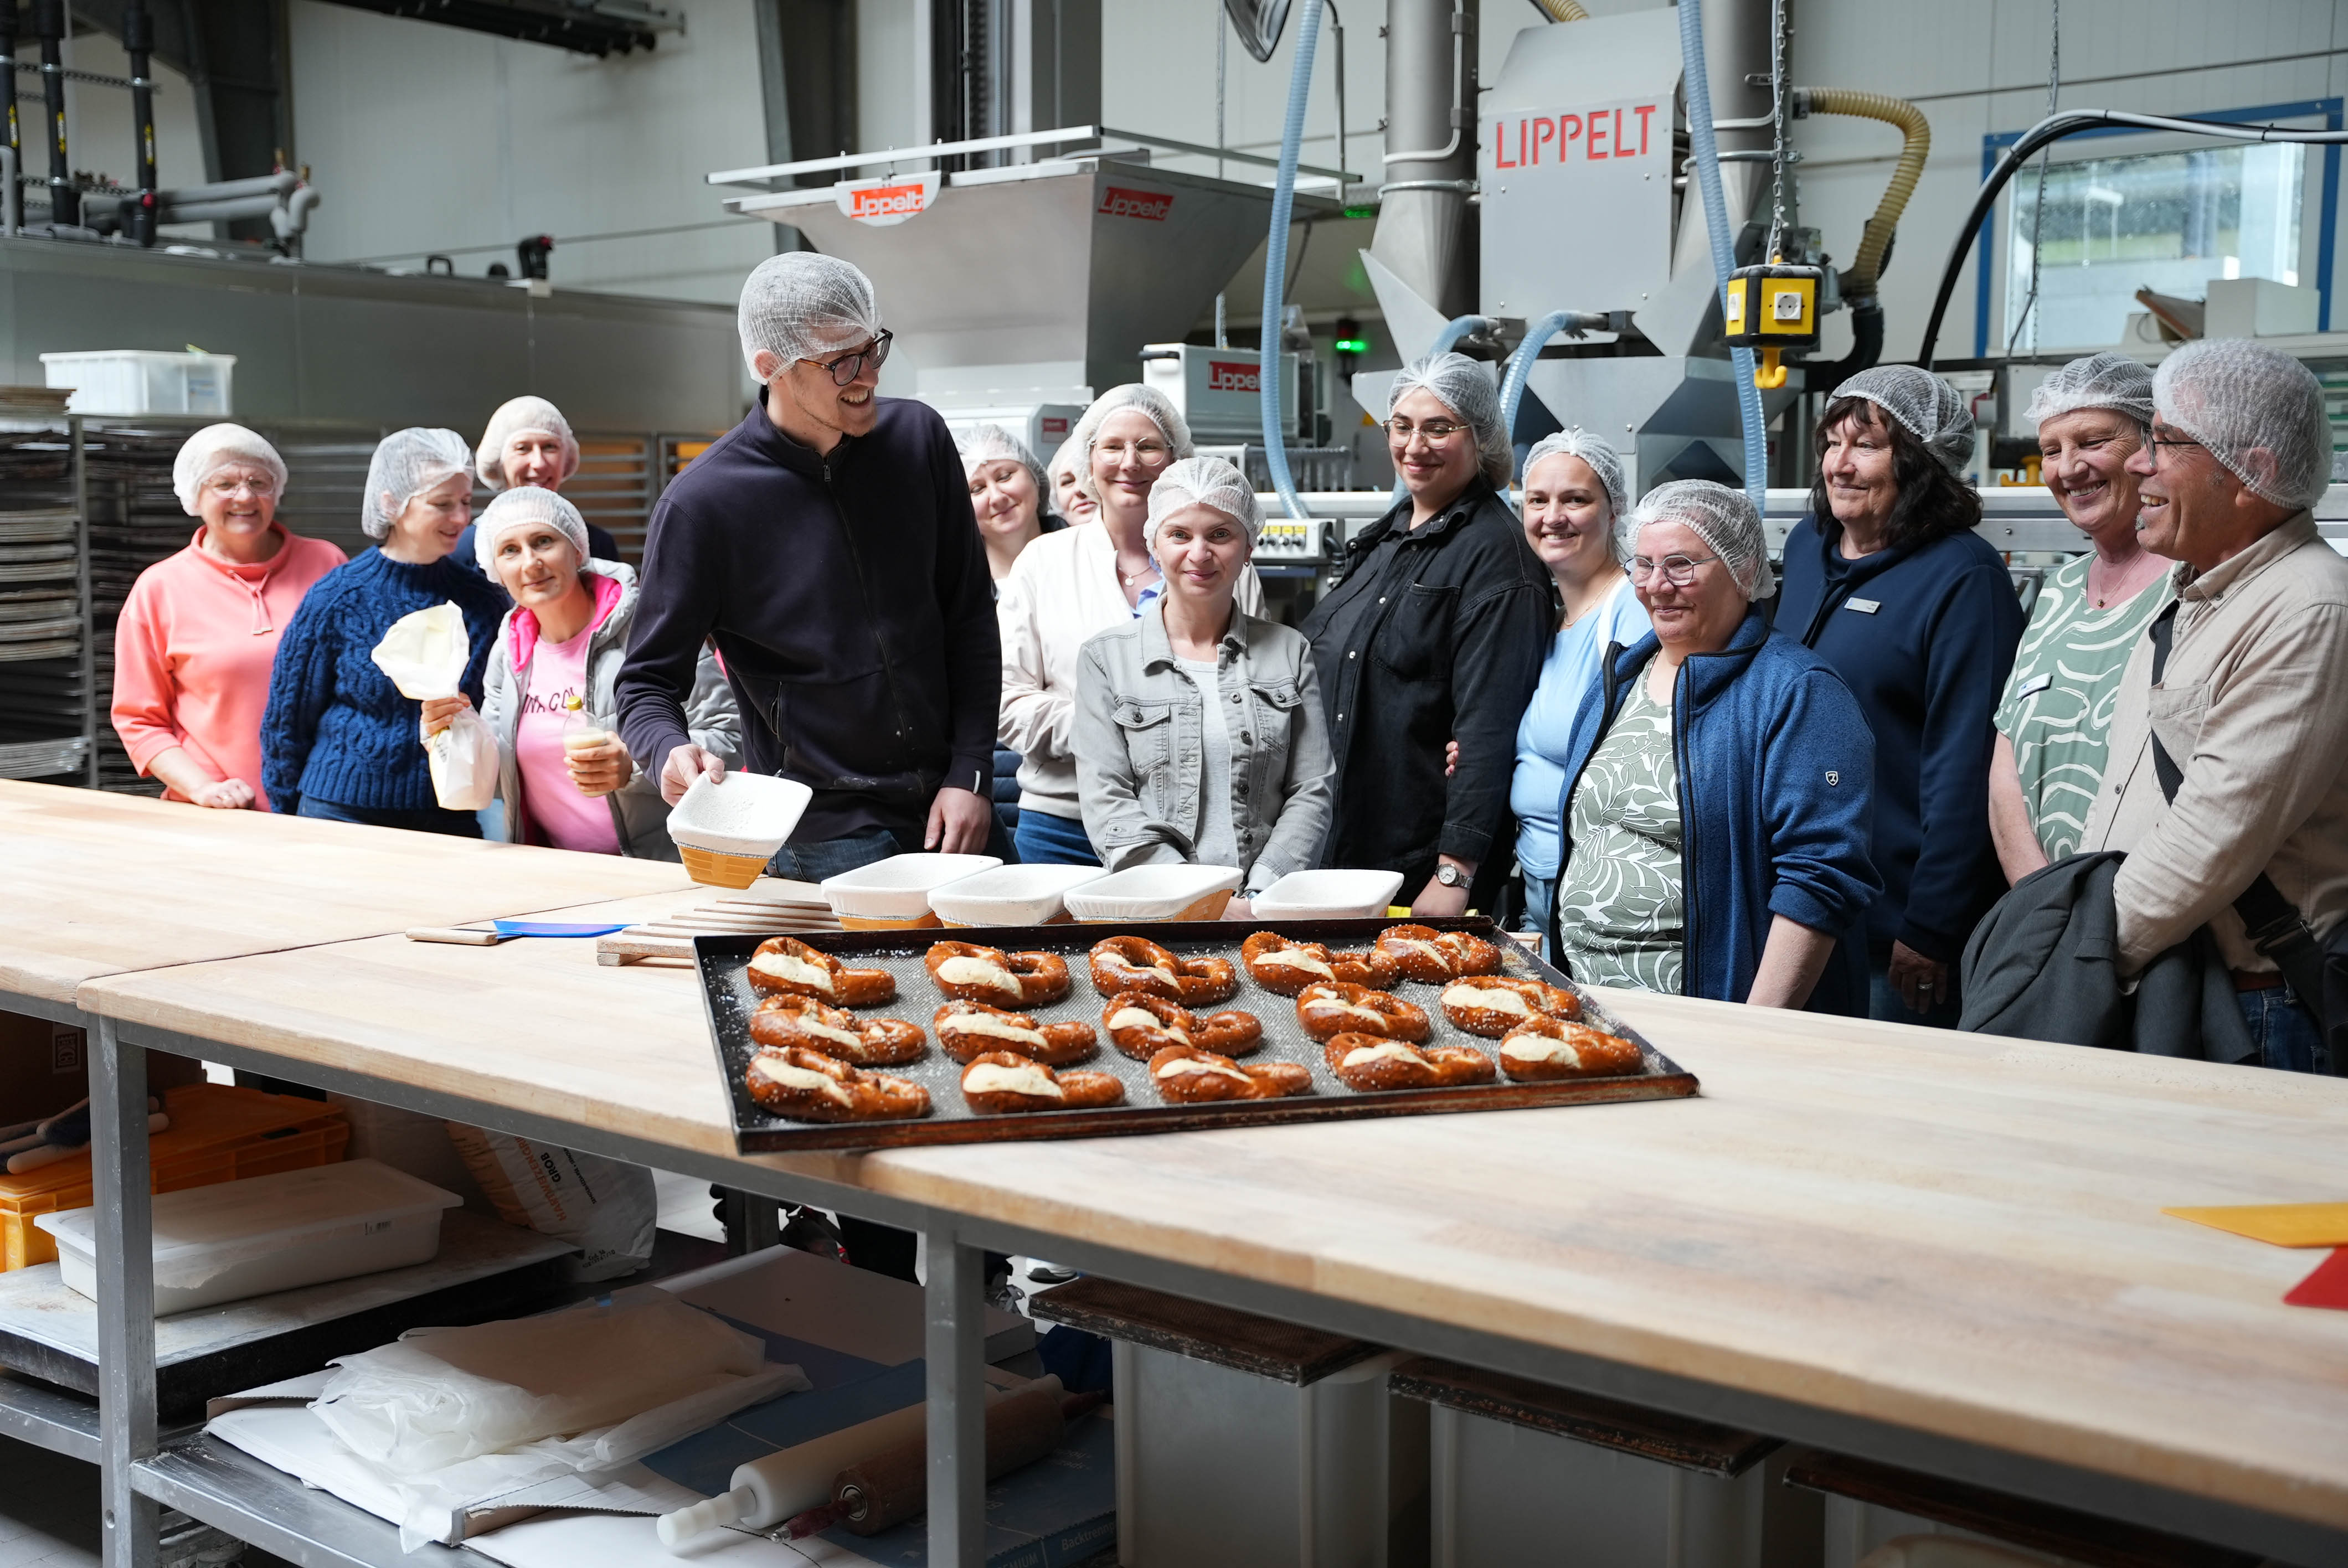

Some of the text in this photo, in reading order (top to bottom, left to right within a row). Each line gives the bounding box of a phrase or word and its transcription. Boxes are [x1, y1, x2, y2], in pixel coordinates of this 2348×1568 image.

[1496, 104, 1656, 169] LIPPELT
[851, 190, 923, 218] Lippelt
[1098, 189, 1168, 219] Lippelt
[1209, 364, 1260, 391] Lippel
[514, 1136, 567, 1221] HARTWEIZENGRI
[540, 1152, 561, 1183] GROB
[1061, 1523, 1116, 1551] Backtrennp
